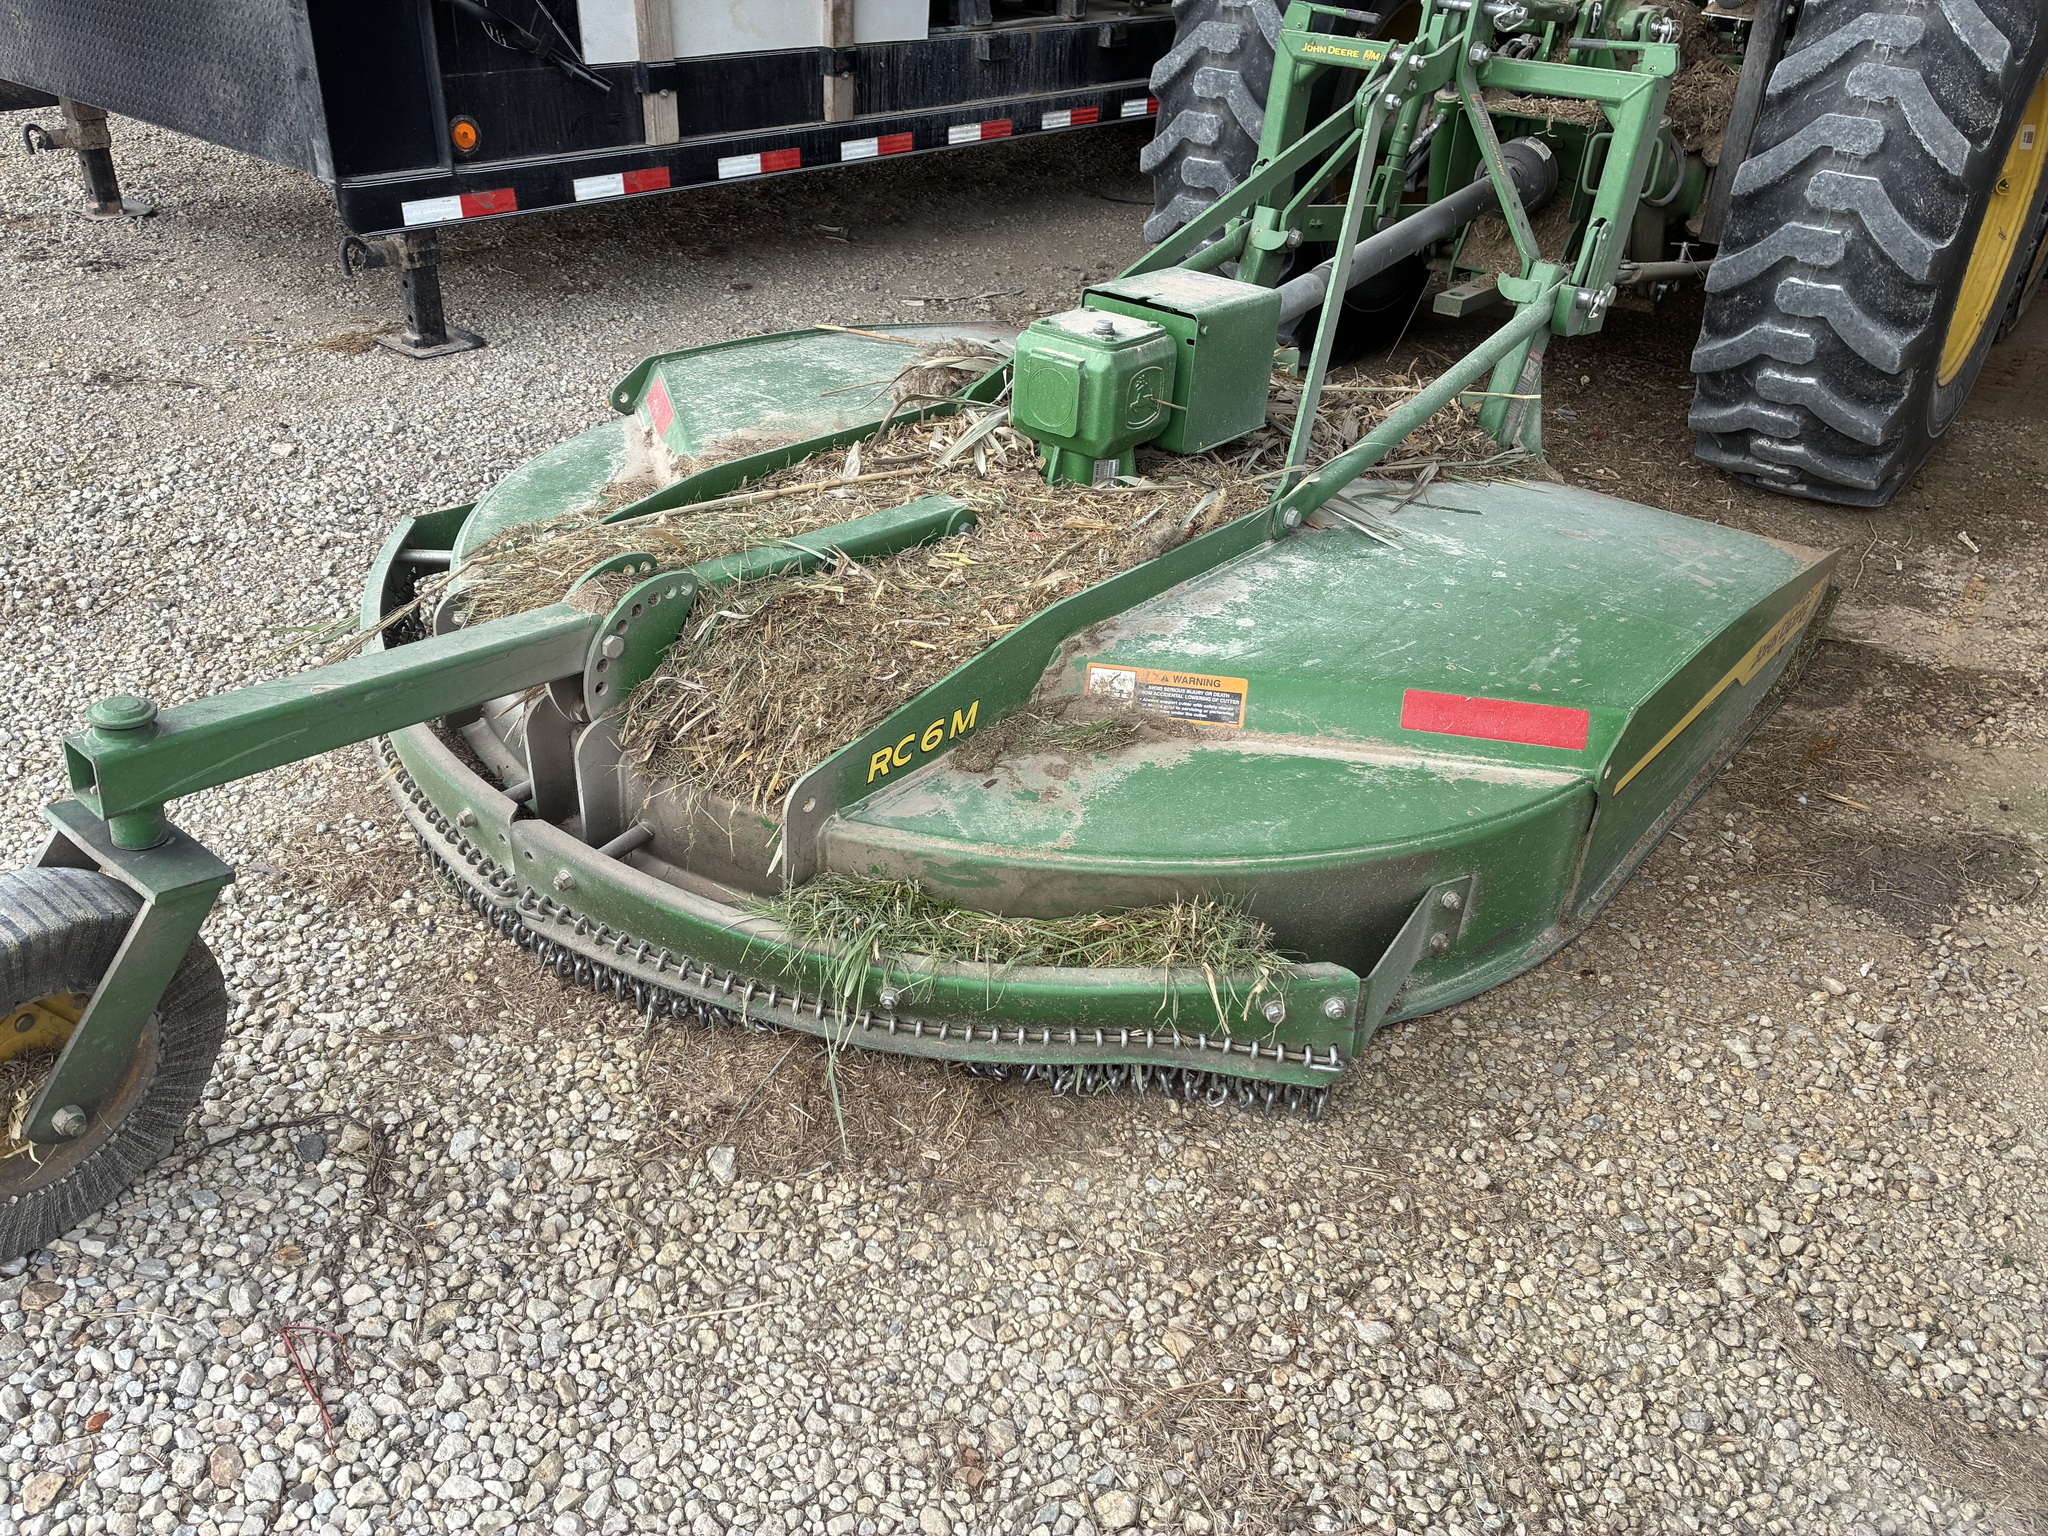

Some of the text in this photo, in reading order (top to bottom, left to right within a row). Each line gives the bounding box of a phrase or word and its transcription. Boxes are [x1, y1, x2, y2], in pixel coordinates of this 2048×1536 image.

[1301, 43, 1327, 54] JOHN
[1327, 45, 1360, 58] DEERE
[1173, 675, 1221, 688] WARNING
[1153, 691, 1185, 699] ACCIDENTAL
